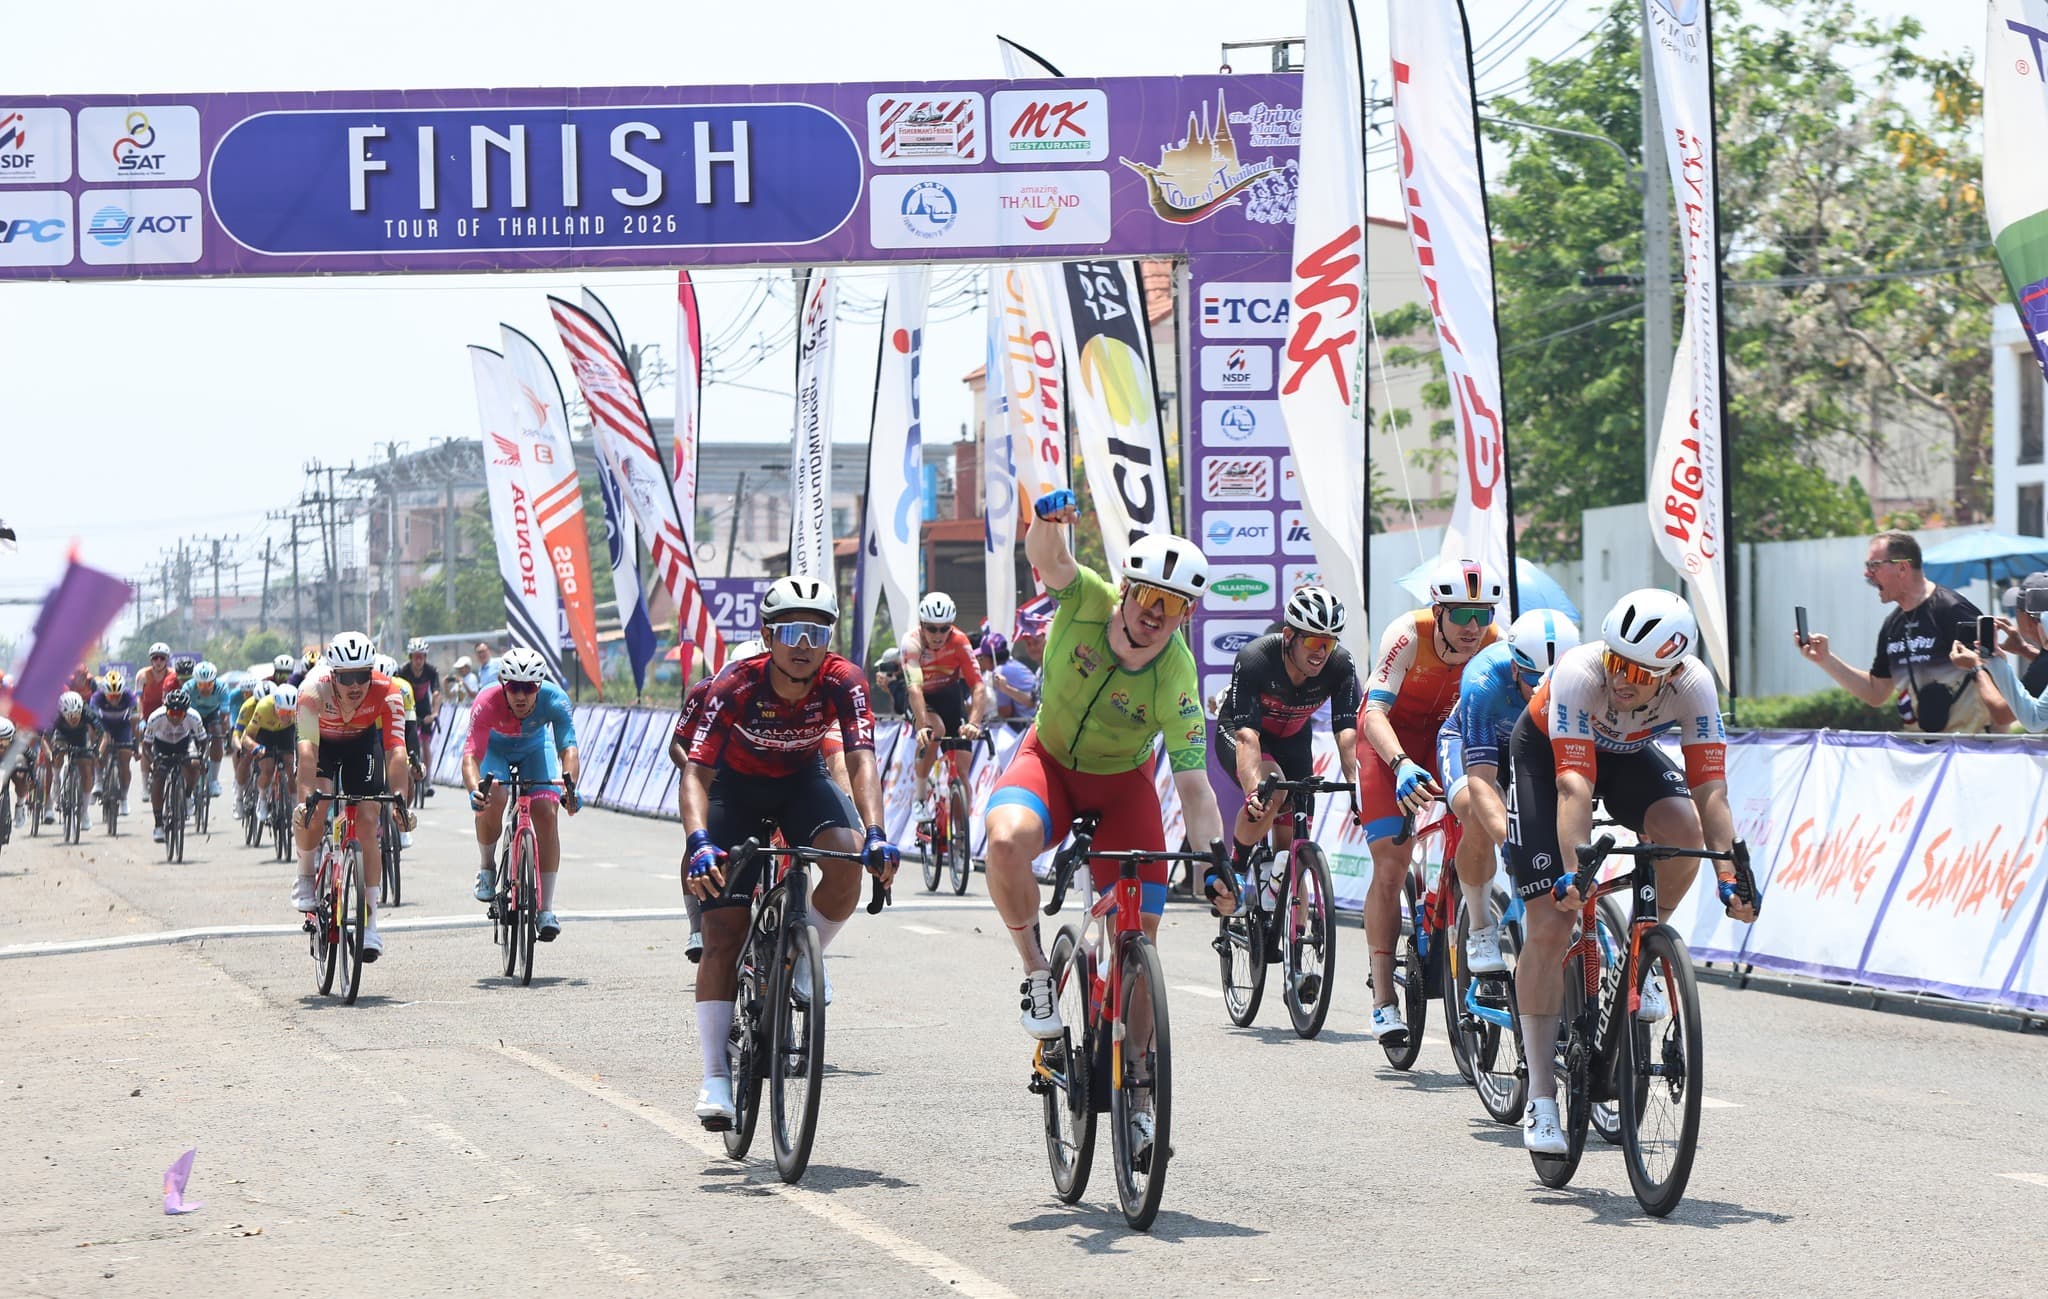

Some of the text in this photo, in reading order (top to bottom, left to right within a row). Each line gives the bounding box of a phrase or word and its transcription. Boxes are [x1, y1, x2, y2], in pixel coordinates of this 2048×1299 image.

[1009, 101, 1089, 138] MK
[1009, 141, 1091, 151] RESTAURANTS
[118, 154, 166, 170] SAT
[347, 120, 751, 212] FINISH
[1020, 185, 1058, 196] amazing
[1159, 181, 1197, 208] Tour
[1215, 157, 1274, 191] Thailand
[999, 194, 1080, 209] THAILAND
[136, 216, 193, 234] AOT
[384, 214, 678, 239] TOUR OF THAILAND 2026
[1222, 373, 1251, 383] NSDF
[1236, 526, 1269, 538] AOT
[1217, 583, 1263, 592] TALAADTHAI
[714, 592, 757, 628] 25
[676, 698, 699, 732] HELAZ
[848, 684, 872, 741] HELAZ
[690, 695, 725, 753] HELAZ
[746, 724, 828, 736] MALAYSIA
[1189, 736, 1207, 746] SA
[1776, 813, 1887, 904] SAMYANG
[1907, 824, 2034, 923] SAMYANG
